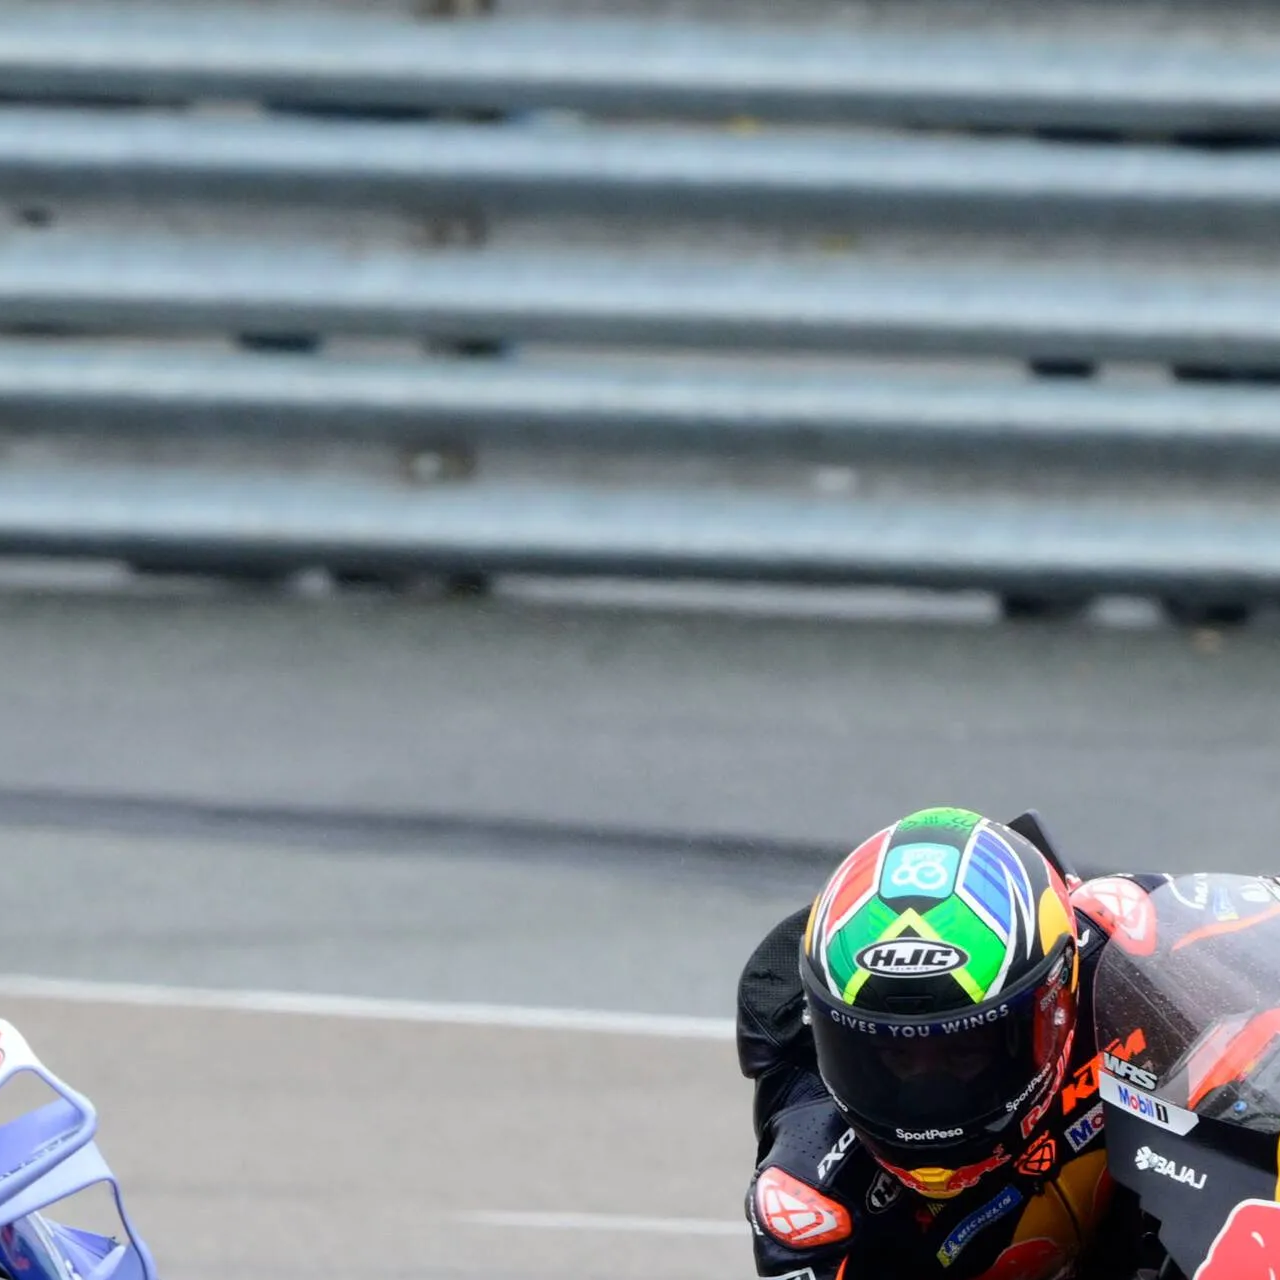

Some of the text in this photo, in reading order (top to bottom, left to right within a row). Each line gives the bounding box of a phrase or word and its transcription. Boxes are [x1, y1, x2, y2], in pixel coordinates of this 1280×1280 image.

[871, 949, 950, 968] HJC
[831, 1003, 1010, 1038] GIVES YOU WINGS
[1061, 1028, 1146, 1116] KTM
[1104, 1052, 1158, 1090] WRS
[1118, 1084, 1154, 1119] Mobil
[895, 1126, 964, 1142] SportPesa
[957, 1195, 1013, 1243] MICHELIN
